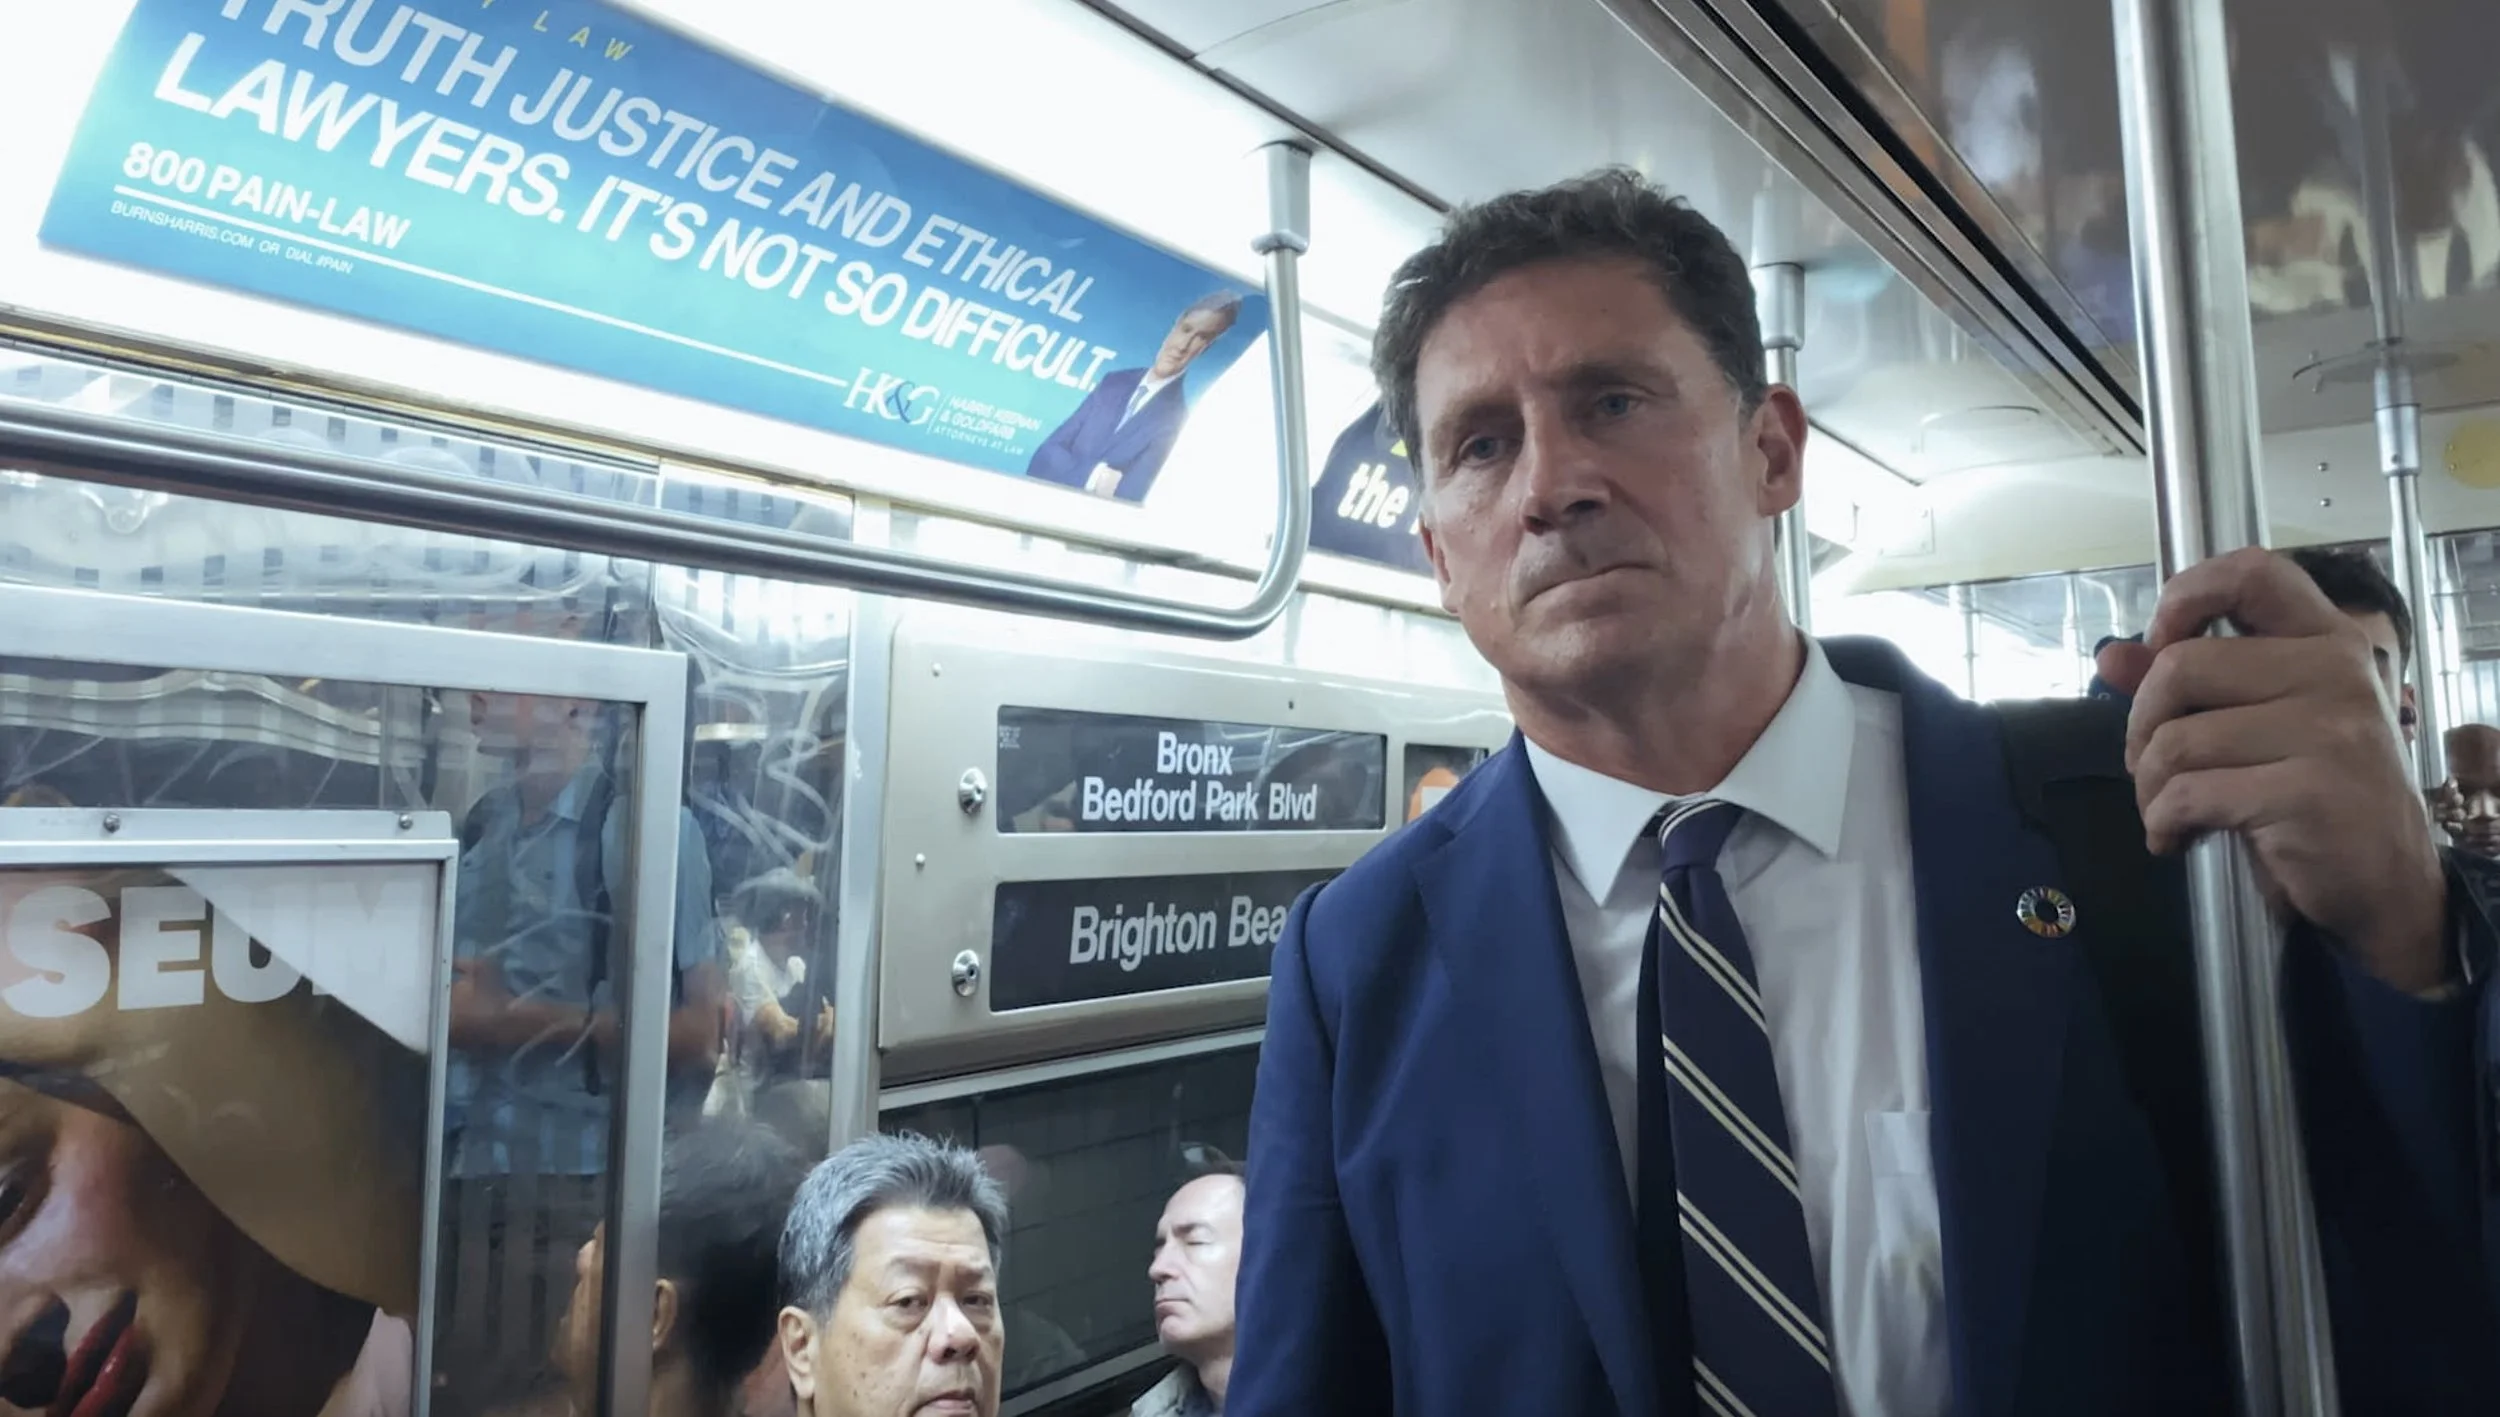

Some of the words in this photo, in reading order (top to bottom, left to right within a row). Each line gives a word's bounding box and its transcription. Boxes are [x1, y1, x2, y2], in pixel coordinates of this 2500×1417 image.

[122, 141, 207, 194] 800
[206, 164, 412, 250] PAIN-LAW
[154, 31, 565, 224] LAWYERS.
[577, 174, 707, 261] IT'S
[698, 217, 838, 300] NOT
[825, 261, 908, 327] SO
[901, 292, 1117, 392] DIFFICULT.
[509, 67, 798, 209] JUSTICE
[779, 170, 912, 249] AND
[902, 212, 1095, 323] ETHICAL
[110, 200, 254, 250] BURNSHARRIS.COM
[258, 239, 281, 257] OR
[285, 246, 314, 266] DIAL
[932, 425, 989, 448] ATTORNEYS
[990, 440, 1004, 451] AT
[939, 408, 951, 423] &
[949, 395, 996, 419] HARRIS
[1337, 462, 1410, 529] the
[1157, 731, 1234, 777] Bronx
[1082, 776, 1197, 823] Bedford
[1205, 779, 1258, 822] Park
[1268, 783, 1317, 822] Blvd
[1069, 904, 1217, 972] Brighton
